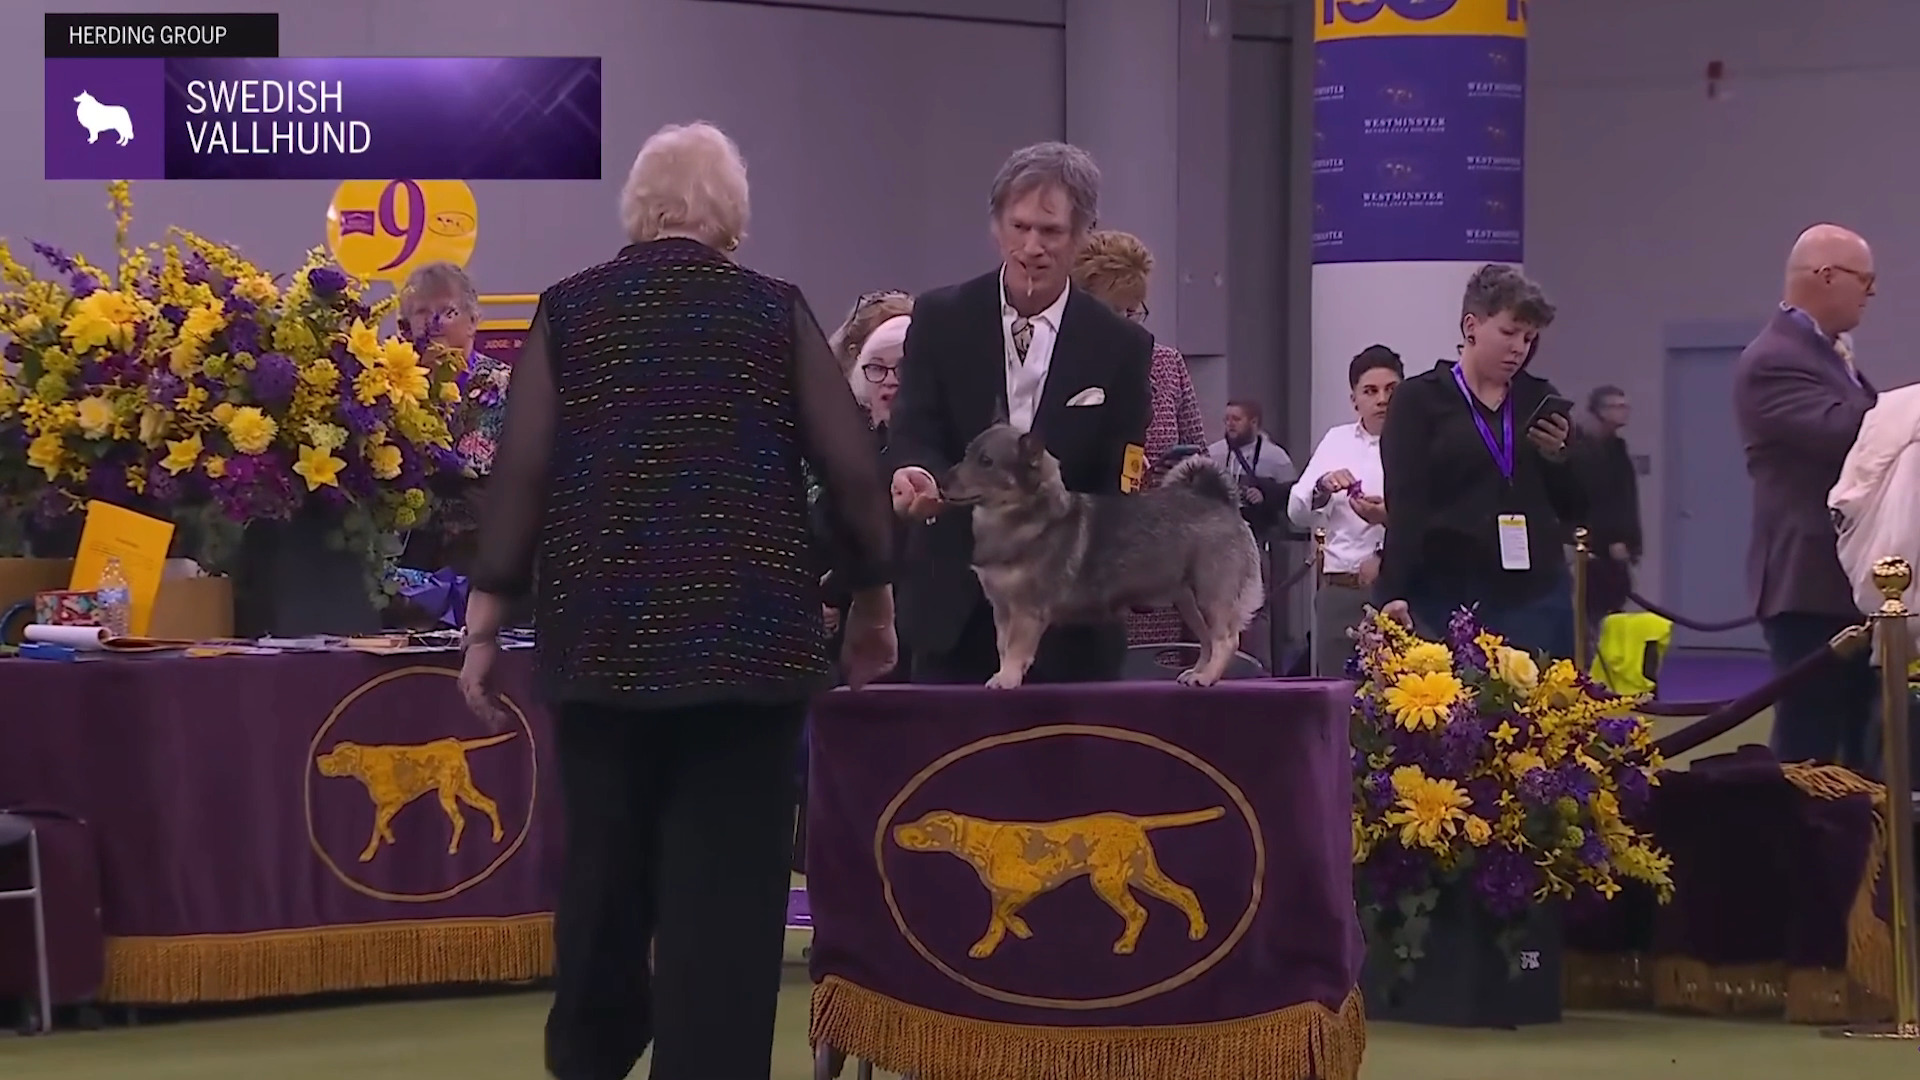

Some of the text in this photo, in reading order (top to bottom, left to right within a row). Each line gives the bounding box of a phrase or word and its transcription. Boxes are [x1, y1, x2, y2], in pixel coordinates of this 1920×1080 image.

[1364, 117, 1446, 127] WESTMINSTER
[1362, 191, 1444, 201] WESTMINSTER
[377, 179, 425, 272] 9
